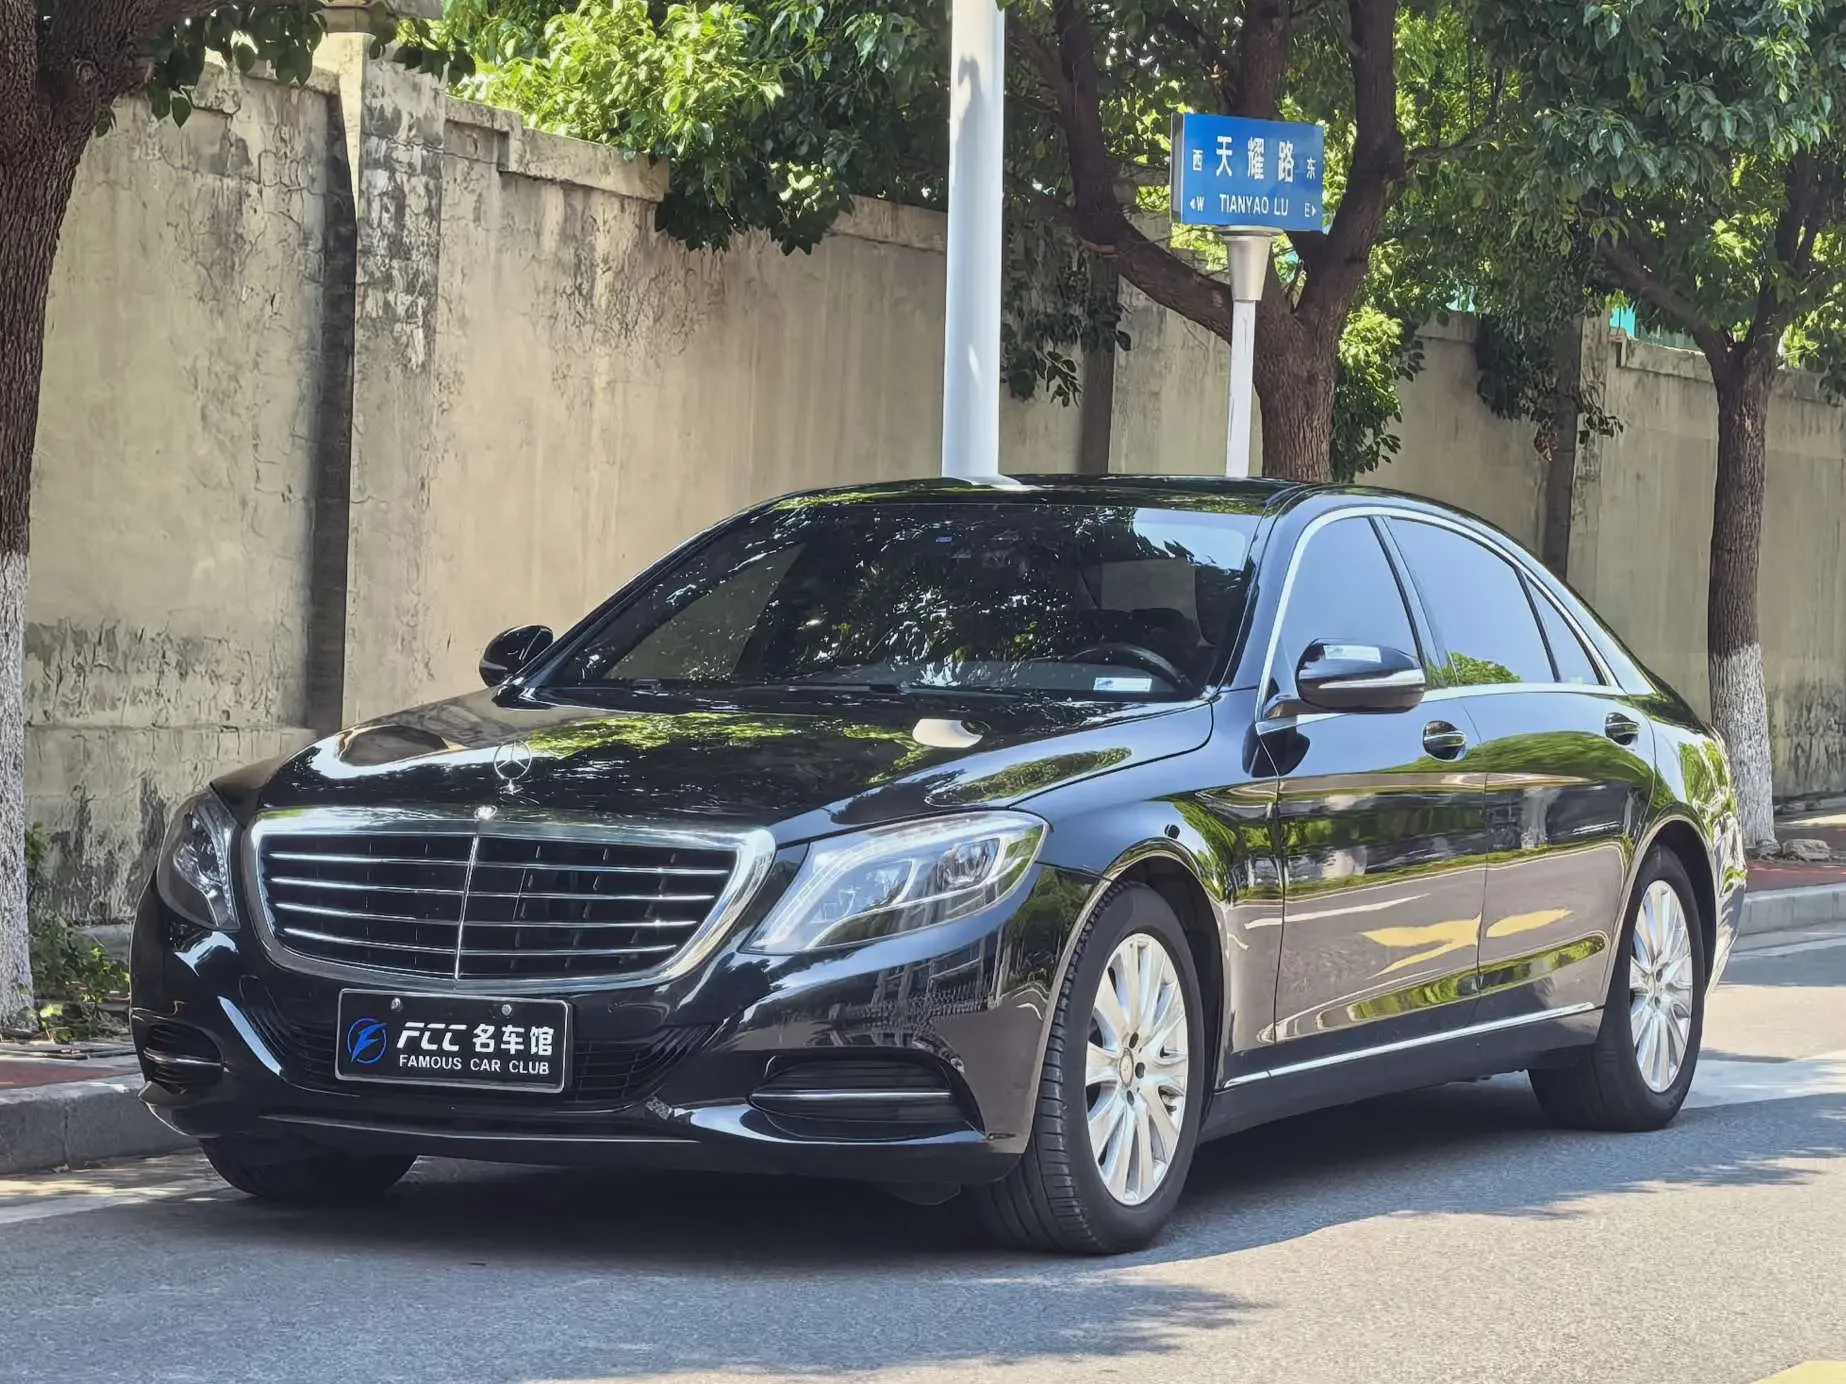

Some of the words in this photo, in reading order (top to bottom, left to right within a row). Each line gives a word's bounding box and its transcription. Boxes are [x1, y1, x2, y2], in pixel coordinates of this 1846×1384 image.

[1192, 149, 1203, 171] 西
[1306, 156, 1316, 180] 东
[1196, 196, 1205, 212] W
[1219, 194, 1270, 215] TIANYAO
[1274, 196, 1289, 216] LU
[1304, 202, 1310, 218] E
[396, 1021, 468, 1052] FCC
[472, 1023, 554, 1056] 名车馆
[399, 1054, 462, 1070] FAMOUS
[470, 1059, 500, 1072] CAR
[509, 1060, 550, 1075] CLUB
